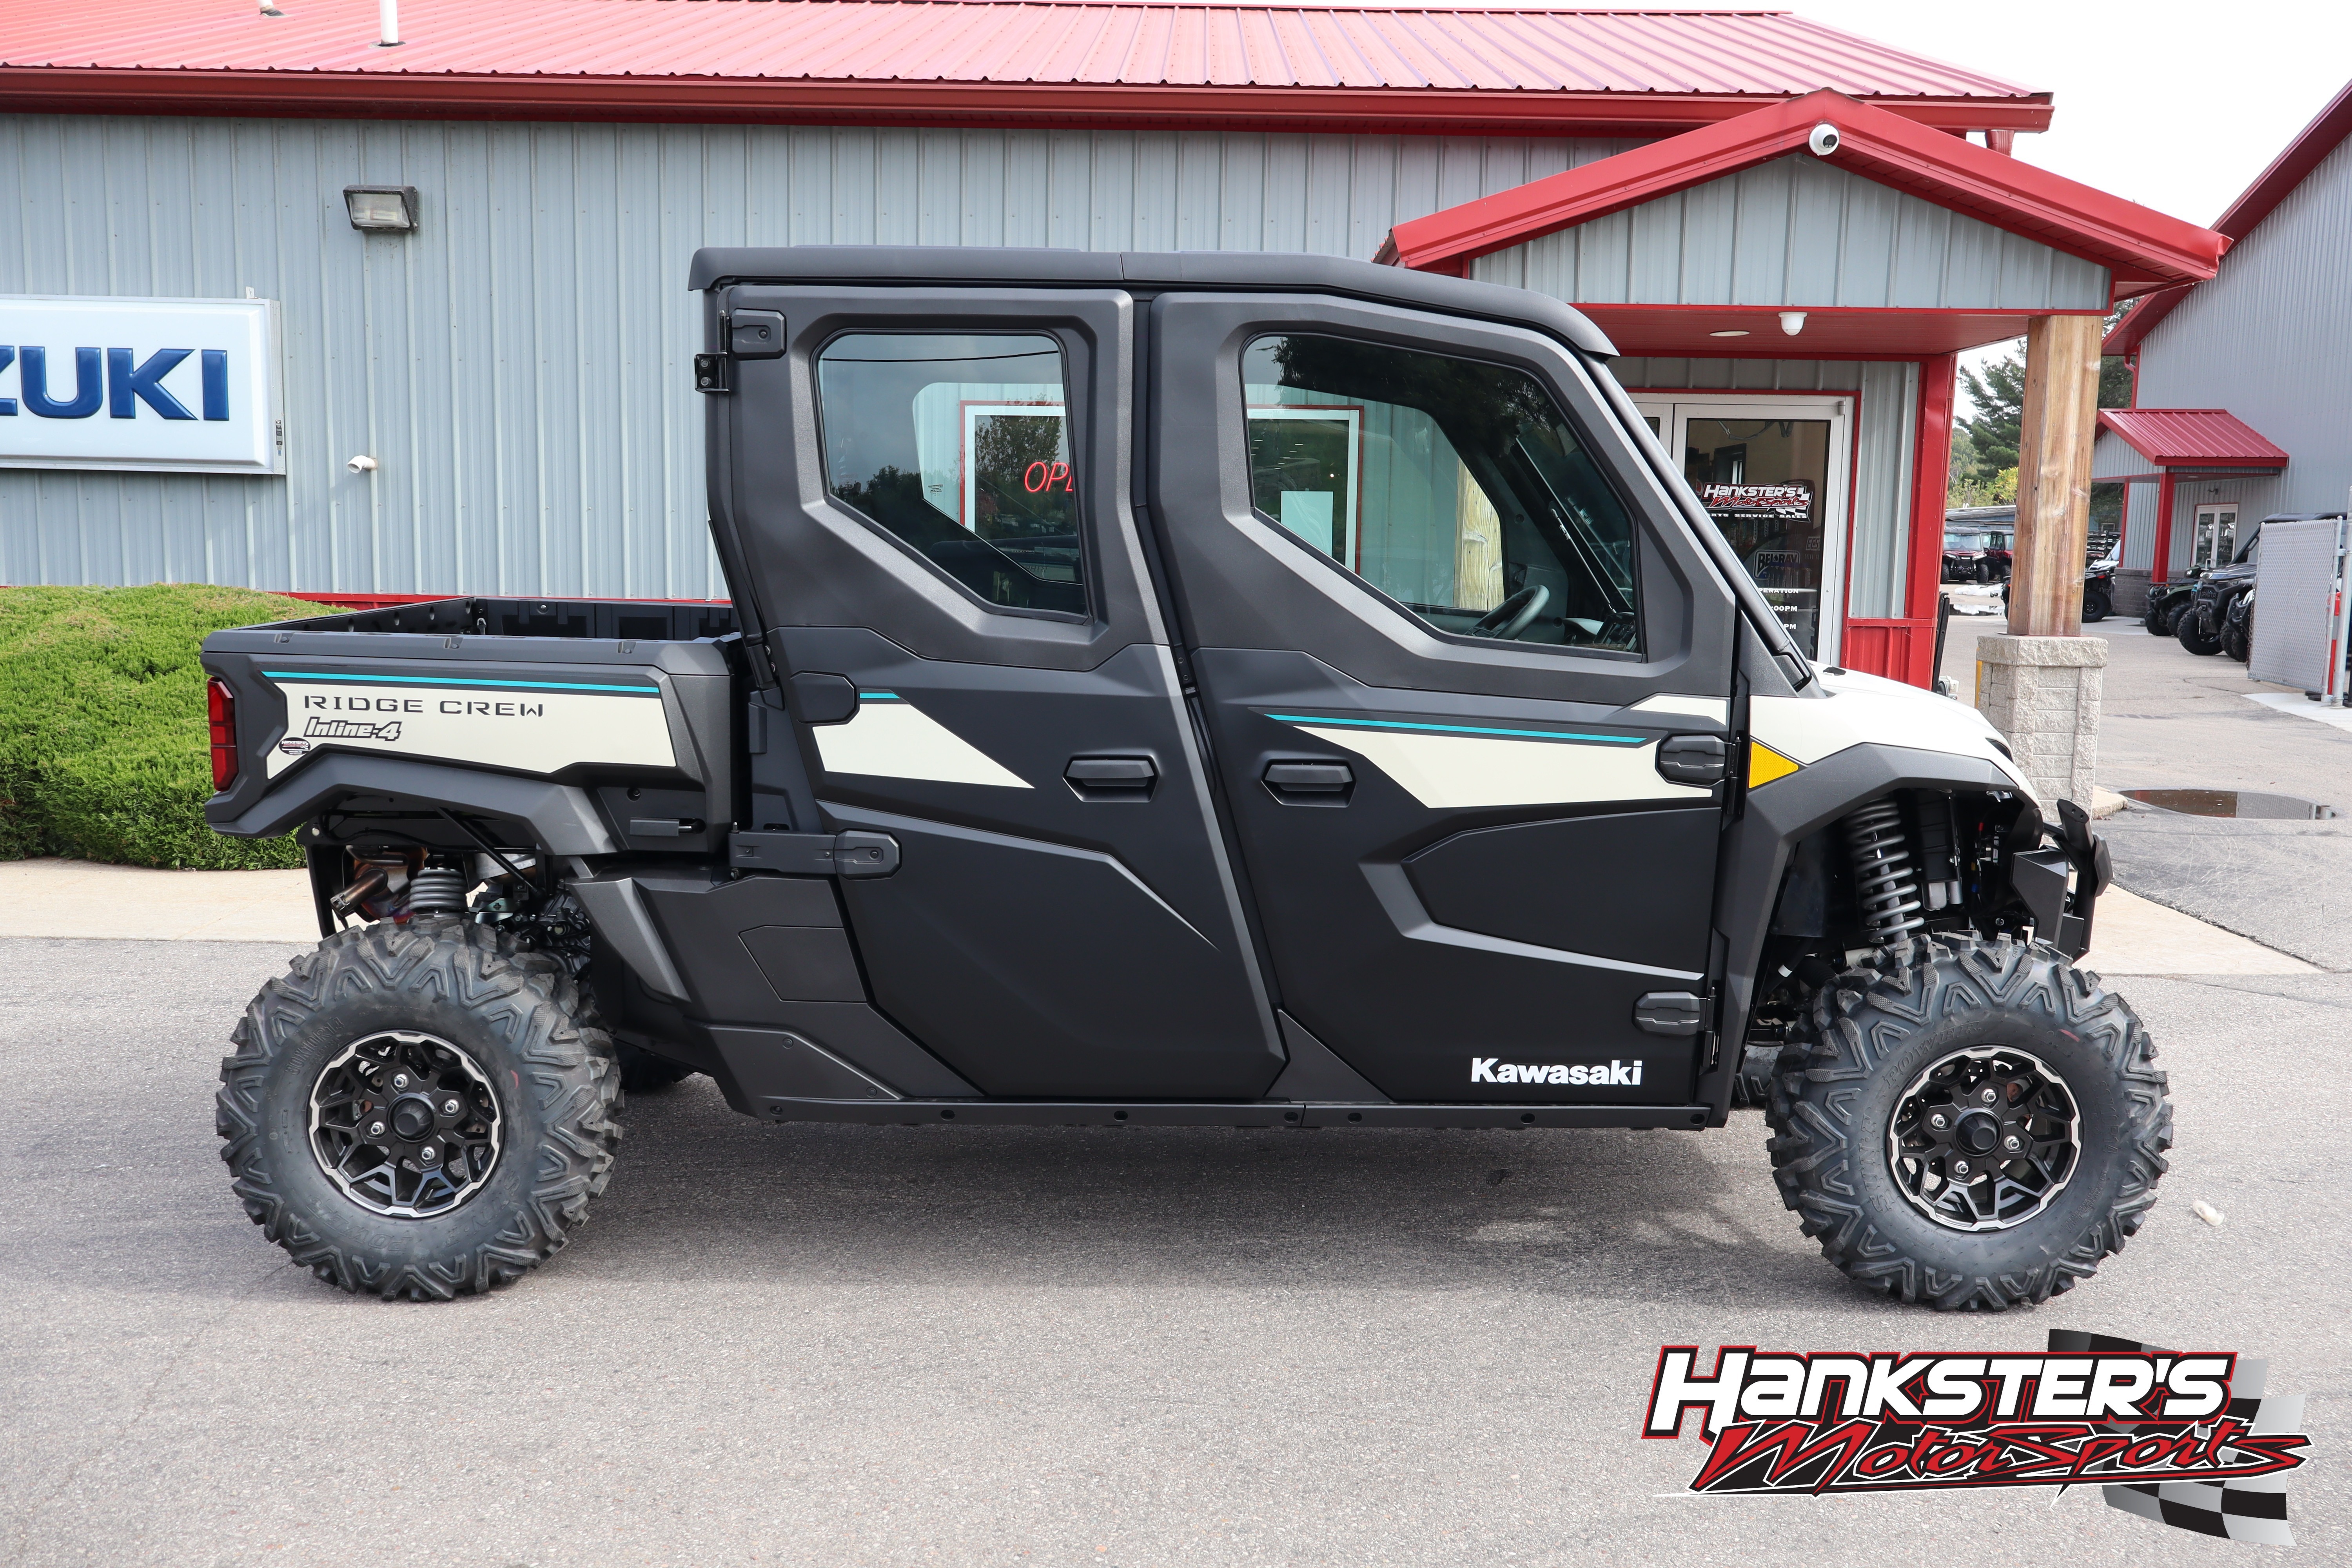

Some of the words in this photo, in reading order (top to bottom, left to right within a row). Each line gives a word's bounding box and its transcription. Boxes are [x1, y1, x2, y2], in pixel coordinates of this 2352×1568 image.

[0, 345, 229, 421] UKI
[305, 695, 423, 713] RIDGE
[439, 700, 543, 717] CREW
[303, 716, 403, 741] Inline-4
[1471, 1058, 1642, 1085] Kawasaki
